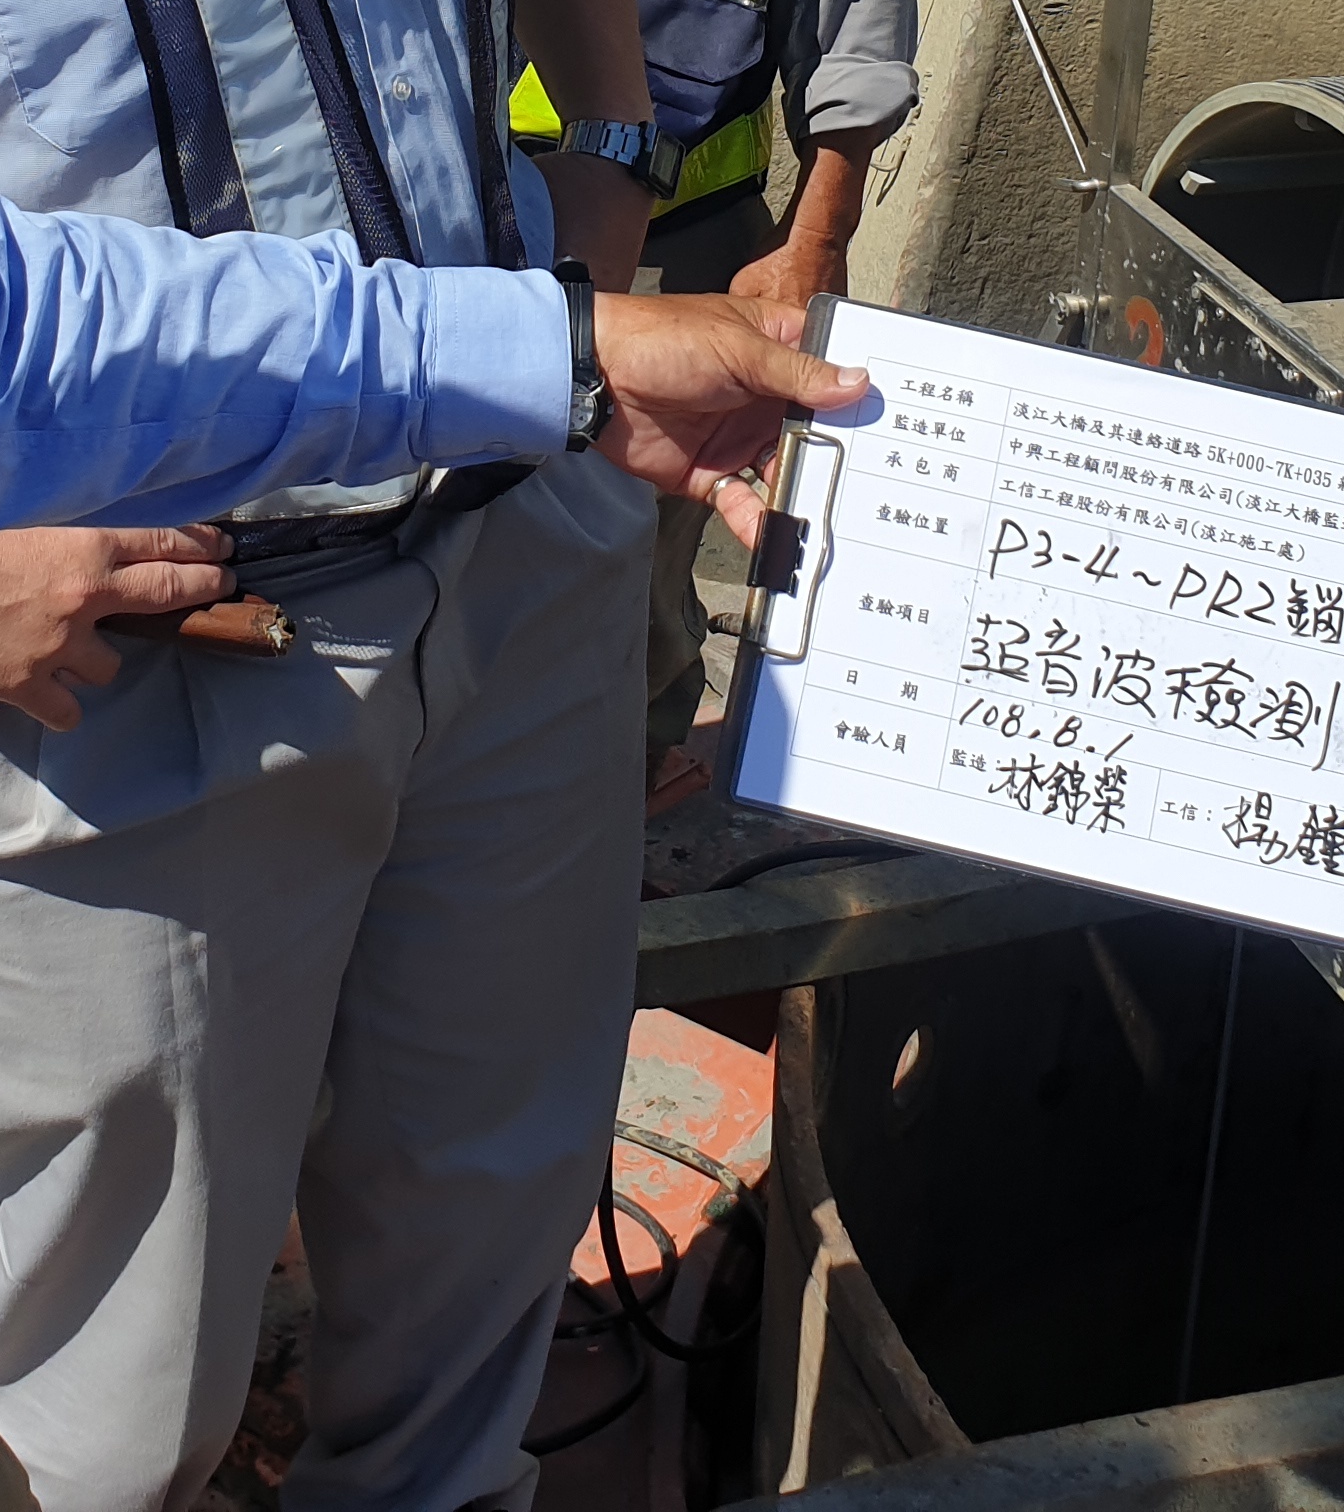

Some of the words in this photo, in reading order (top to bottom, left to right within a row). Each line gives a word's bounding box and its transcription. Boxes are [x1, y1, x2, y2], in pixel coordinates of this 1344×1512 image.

[899, 379, 974, 408] 工程名稱
[891, 413, 967, 444] 監造單位
[1012, 402, 1203, 458] 淡江大橋及其連絡道路
[875, 502, 950, 536] 查驗位置
[858, 592, 931, 625] 查驗項目
[960, 613, 1342, 772] 超音波檢測
[833, 719, 907, 755] 會驗人員
